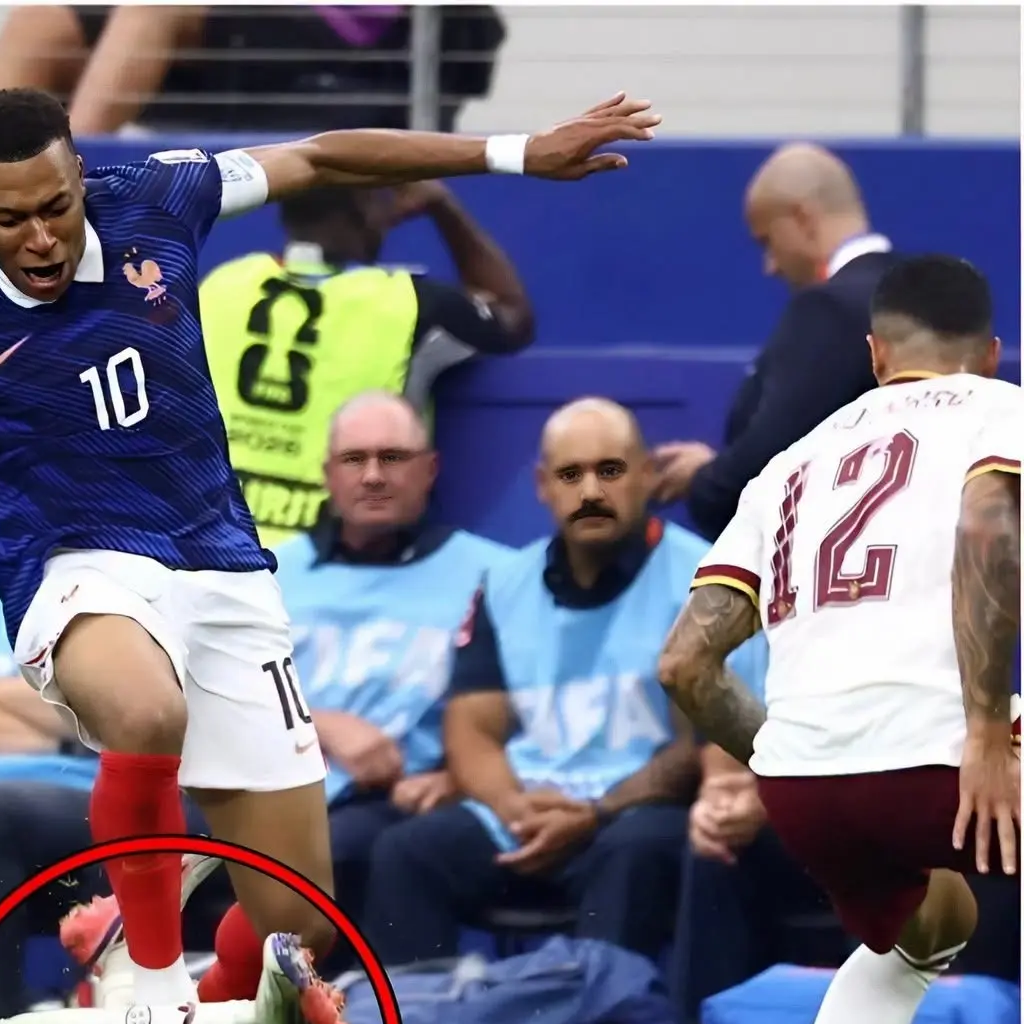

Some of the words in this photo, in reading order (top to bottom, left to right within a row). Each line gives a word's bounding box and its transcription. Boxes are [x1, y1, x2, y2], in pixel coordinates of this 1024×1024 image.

[79, 346, 150, 431] 10
[767, 428, 920, 629] 12
[290, 621, 451, 697] IFA
